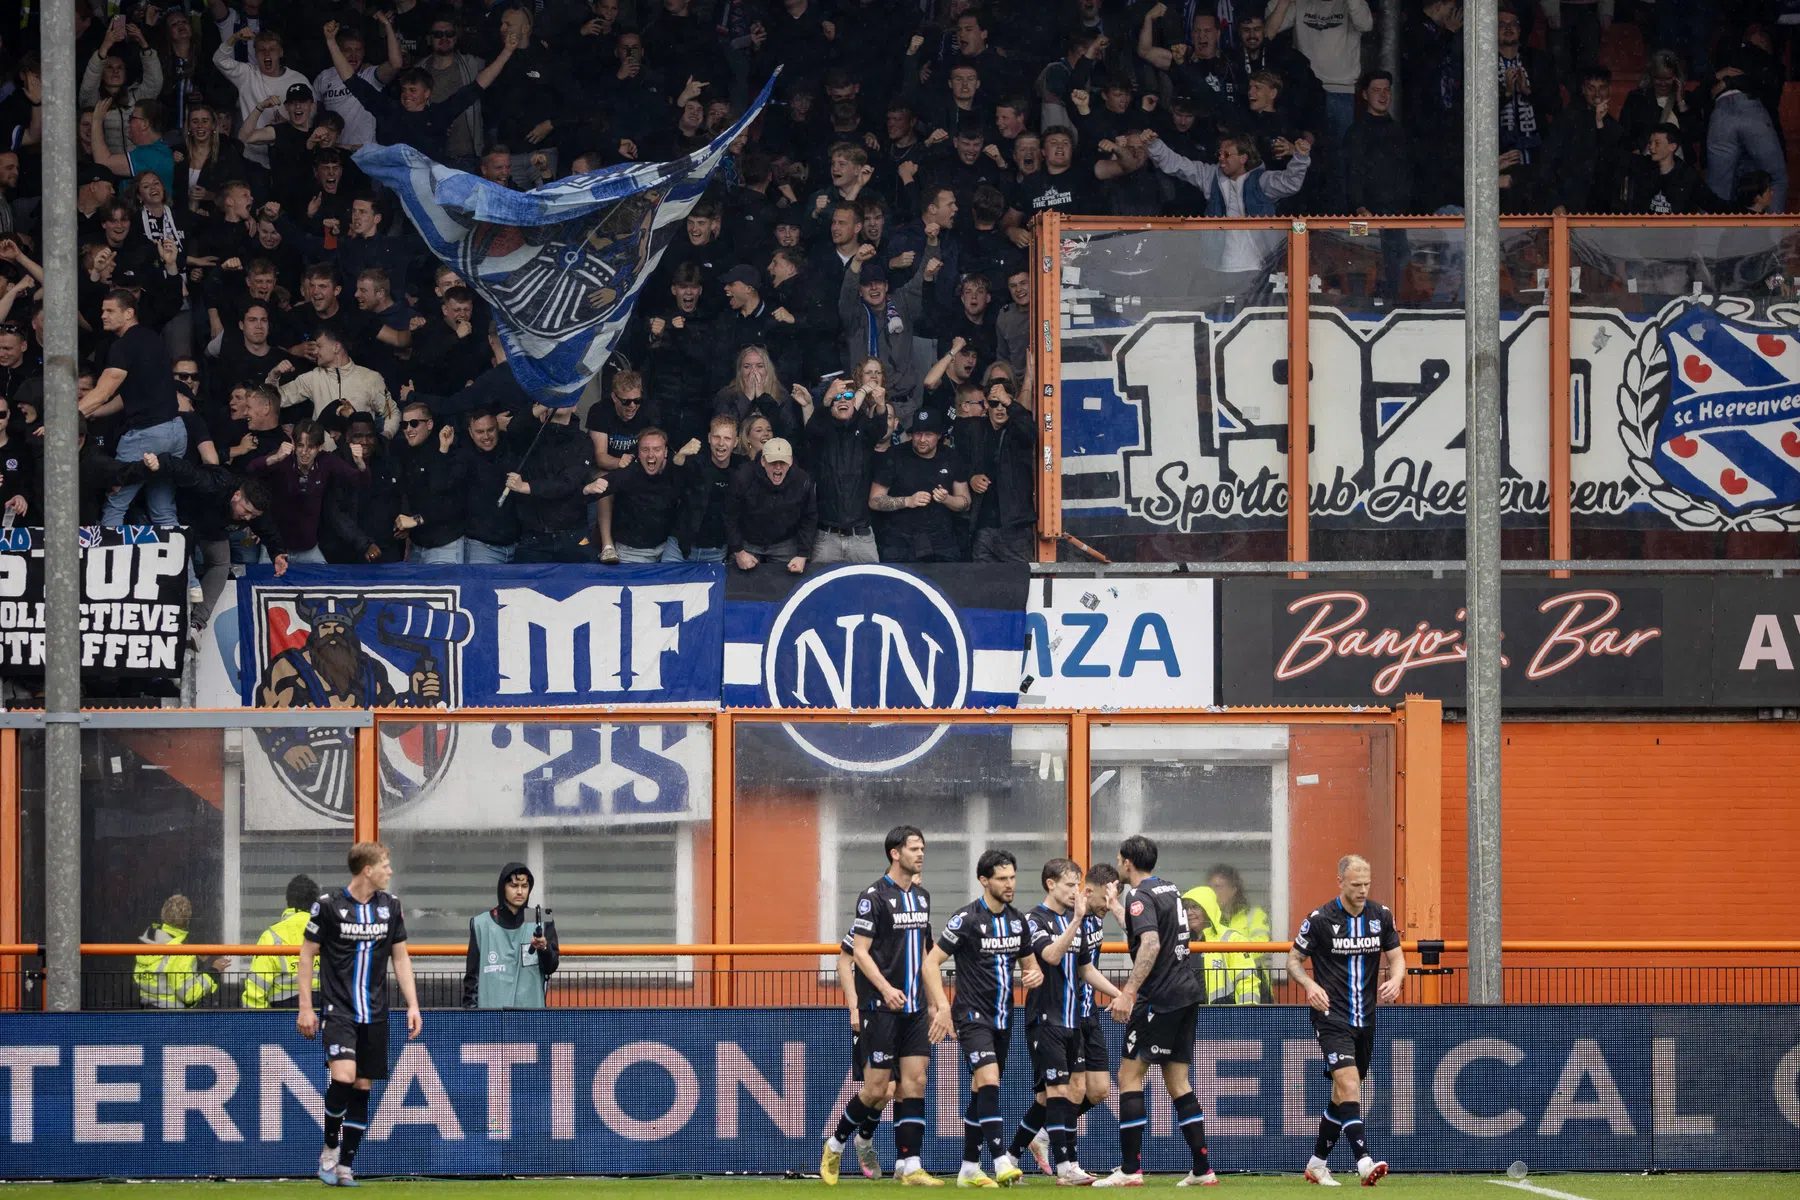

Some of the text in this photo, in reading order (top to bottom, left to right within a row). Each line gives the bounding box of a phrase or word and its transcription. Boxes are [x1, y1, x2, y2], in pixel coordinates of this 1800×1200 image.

[1047, 197, 1072, 206] NORTH
[1115, 309, 1637, 511] 1920
[1143, 461, 1358, 531] Sportcub
[0, 532, 186, 600] SOP
[0, 601, 181, 632] OLLCTIEVE
[0, 631, 178, 669] TRFFEN
[1275, 589, 1662, 696] Banjo' Bar
[1738, 614, 1800, 670] A
[340, 922, 389, 935] WOLKOM
[981, 936, 1021, 949] WOLKOM
[1332, 937, 1381, 949] WOLKOM
[1128, 1030, 1137, 1043] 4
